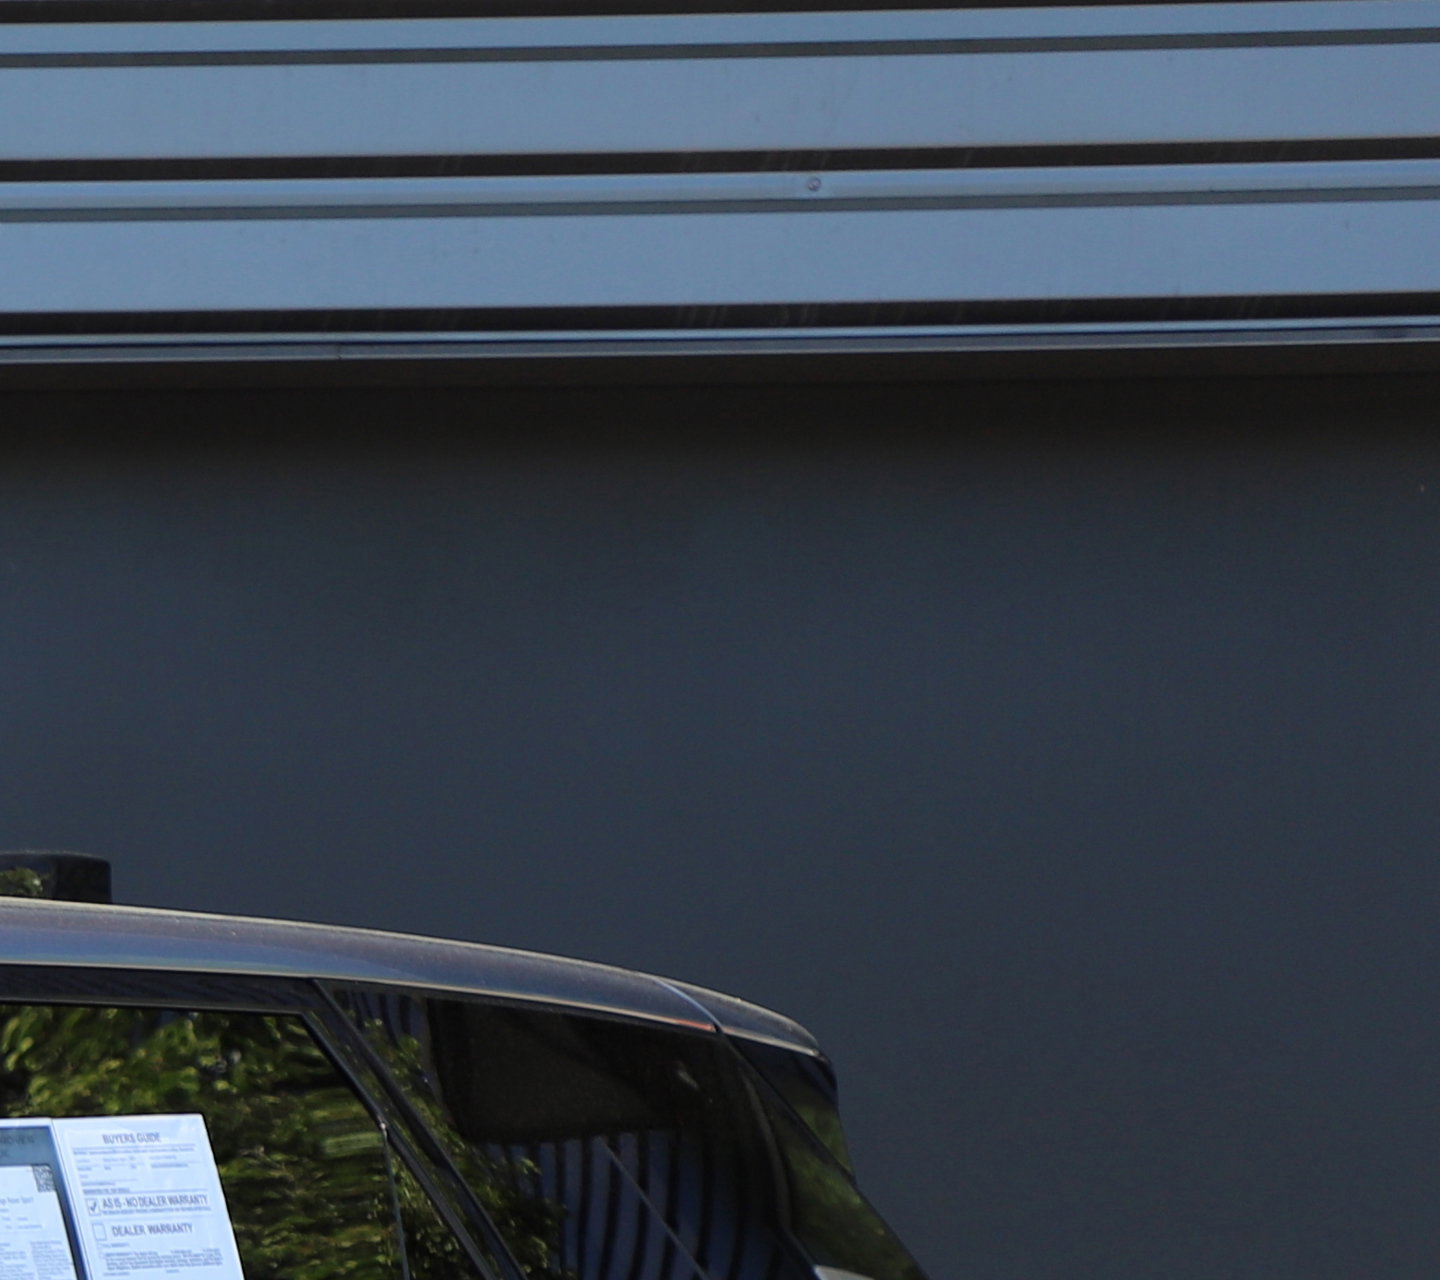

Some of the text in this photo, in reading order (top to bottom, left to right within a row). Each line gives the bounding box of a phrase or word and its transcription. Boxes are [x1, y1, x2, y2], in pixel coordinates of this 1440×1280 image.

[102, 1131, 161, 1145] BUYERS GUIDE
[139, 1195, 168, 1208] DEALER
[168, 1194, 209, 1206] WARRANTY
[112, 1222, 194, 1238] DEALER WARRANTY
